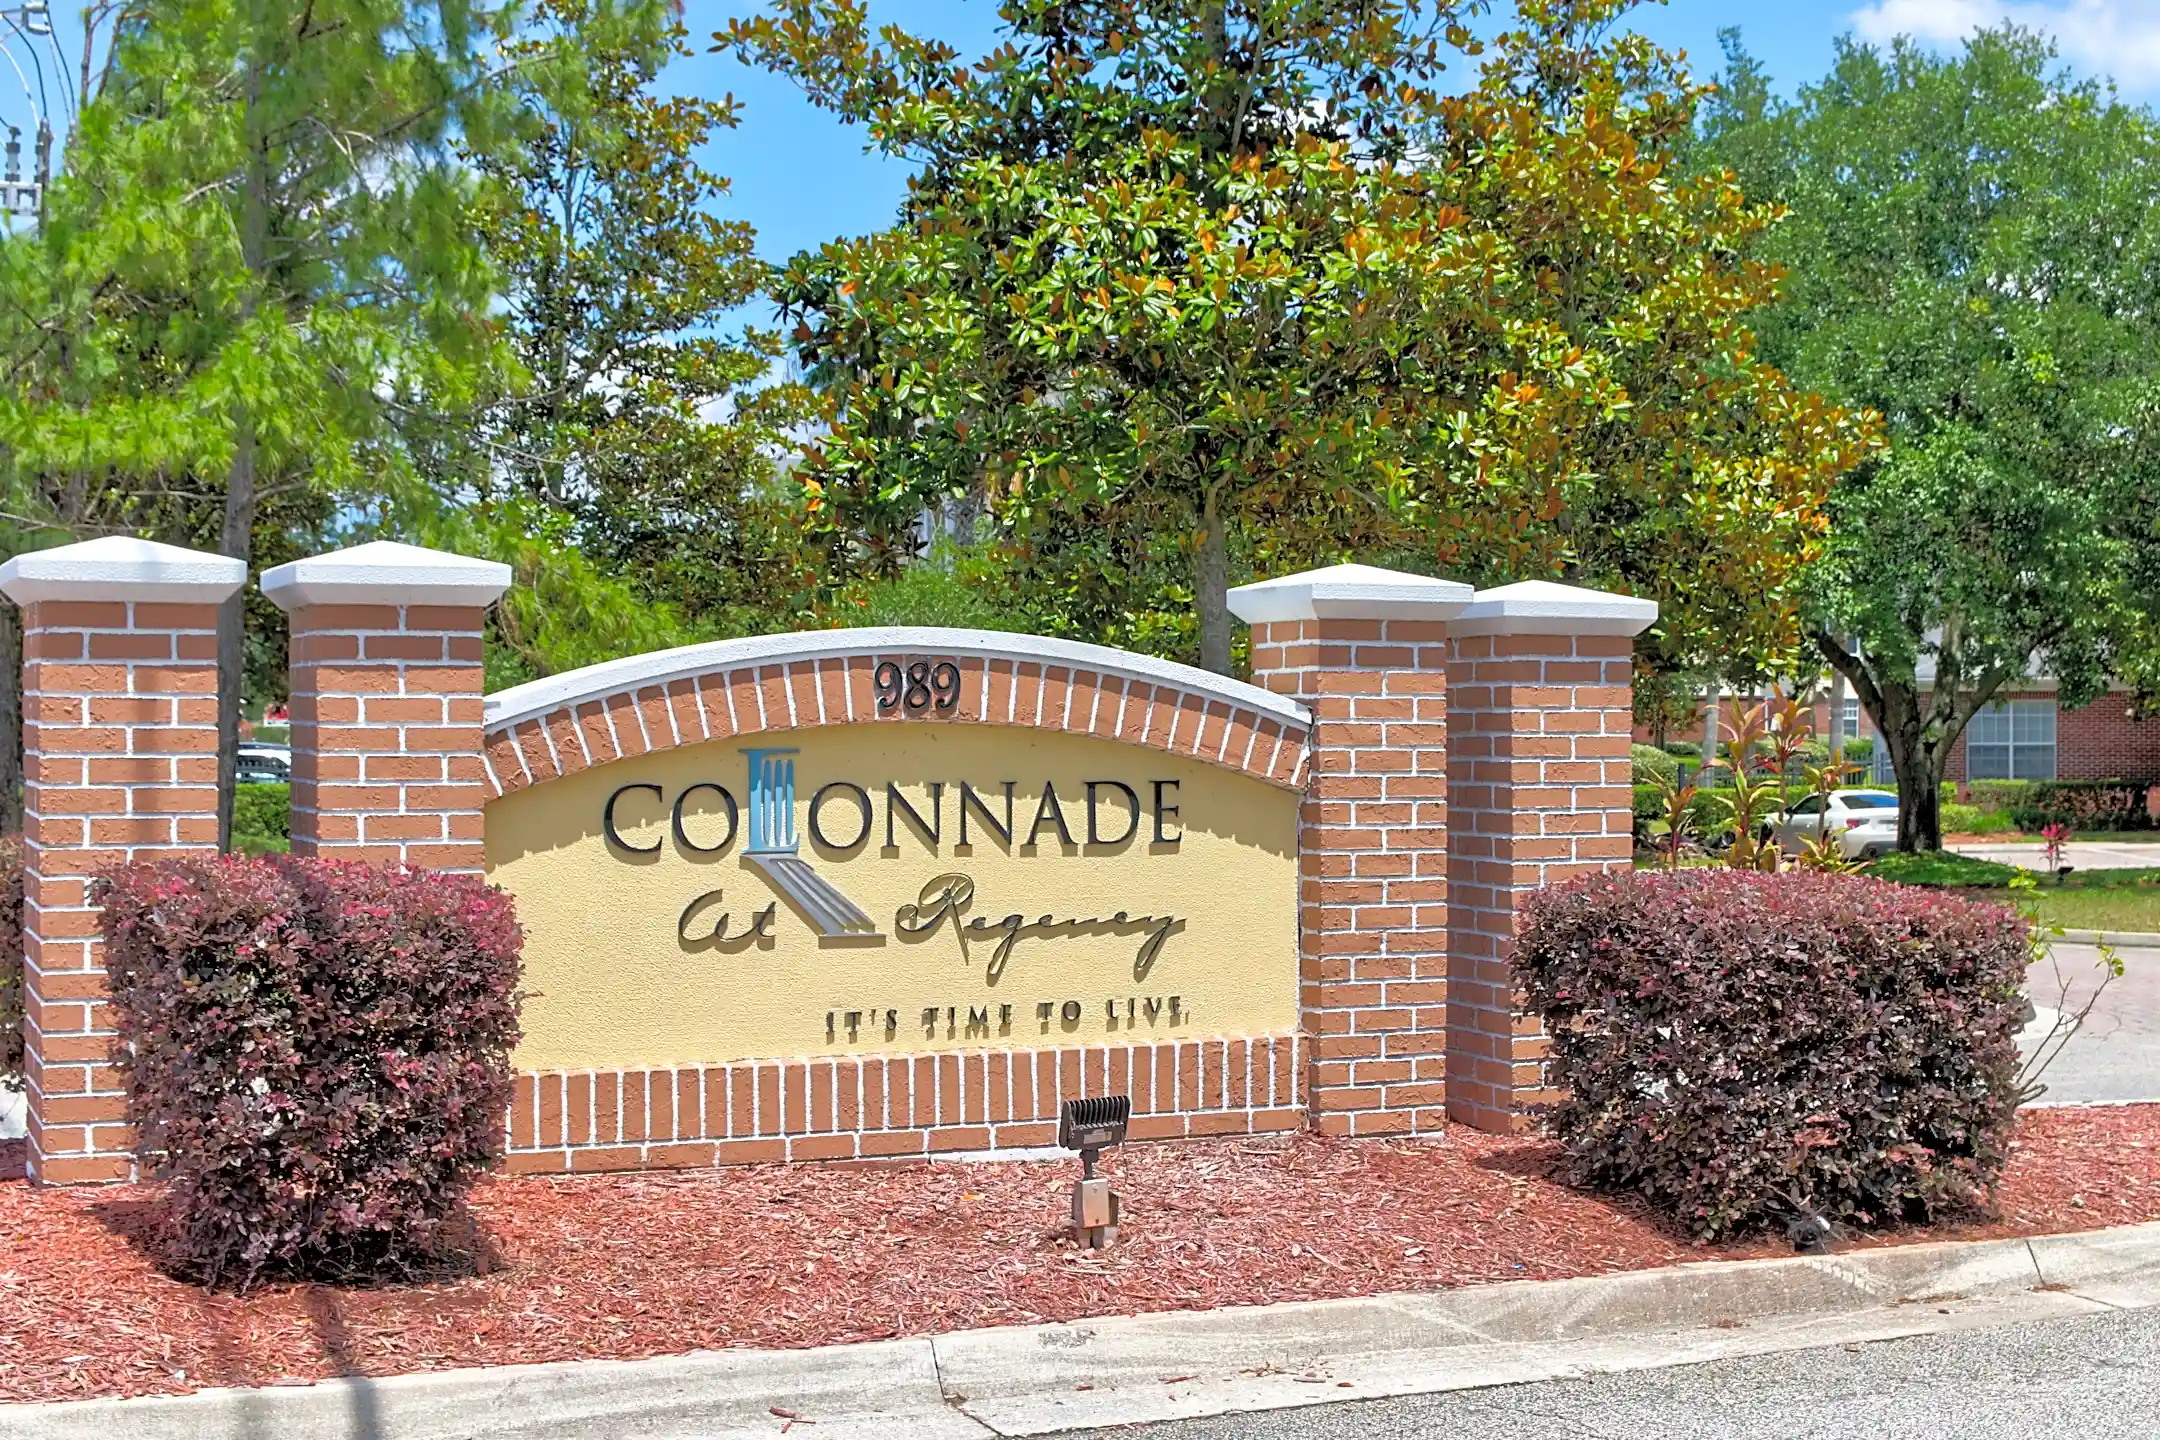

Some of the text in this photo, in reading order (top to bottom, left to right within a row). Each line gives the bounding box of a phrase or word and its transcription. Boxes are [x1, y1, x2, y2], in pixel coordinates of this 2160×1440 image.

[874, 661, 961, 710] 989
[603, 748, 1183, 857] COLONNADE
[895, 872, 1187, 977] Regency
[826, 1007, 898, 1035] IT'S
[923, 1002, 1013, 1033] TIME
[1037, 999, 1082, 1023] TO
